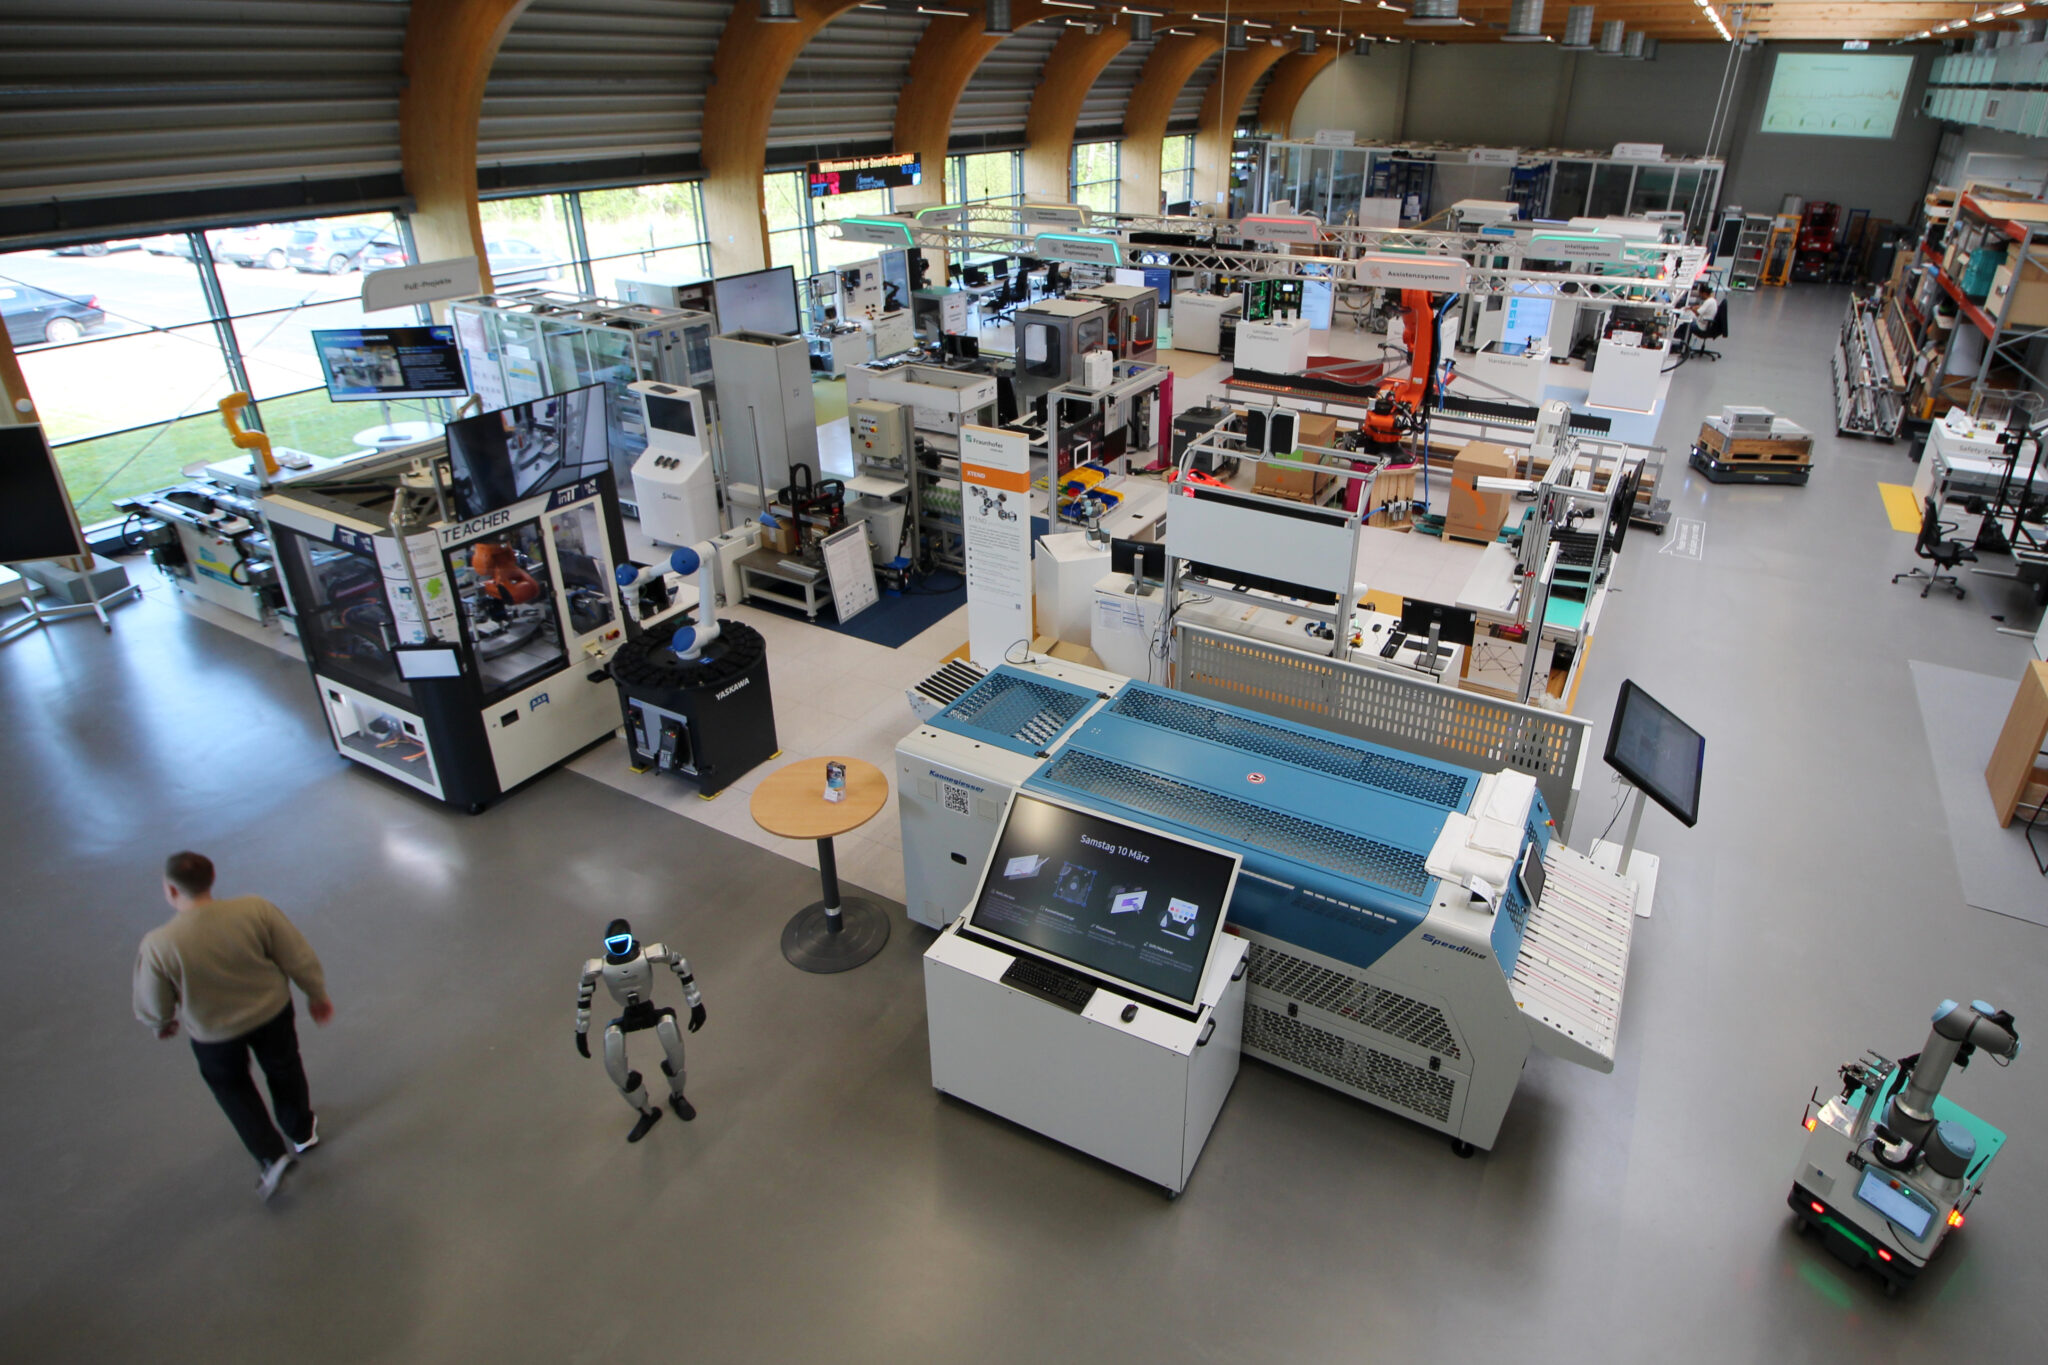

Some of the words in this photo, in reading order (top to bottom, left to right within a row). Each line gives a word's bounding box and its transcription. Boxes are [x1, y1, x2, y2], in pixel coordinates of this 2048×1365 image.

[1564, 243, 1600, 251] Intelligente
[1388, 271, 1450, 281] Assistenzsysteme
[972, 438, 1003, 449] Fraunhofer
[967, 470, 986, 479] XTEND
[557, 484, 580, 505] inIT
[442, 510, 511, 543] TEACHER
[715, 677, 750, 700] YASKAWA
[929, 769, 985, 793] Kannegiesser
[1080, 834, 1116, 854] Samstag
[1118, 846, 1128, 856] 10
[1129, 849, 1150, 863] März
[1421, 933, 1487, 960] Speedline
